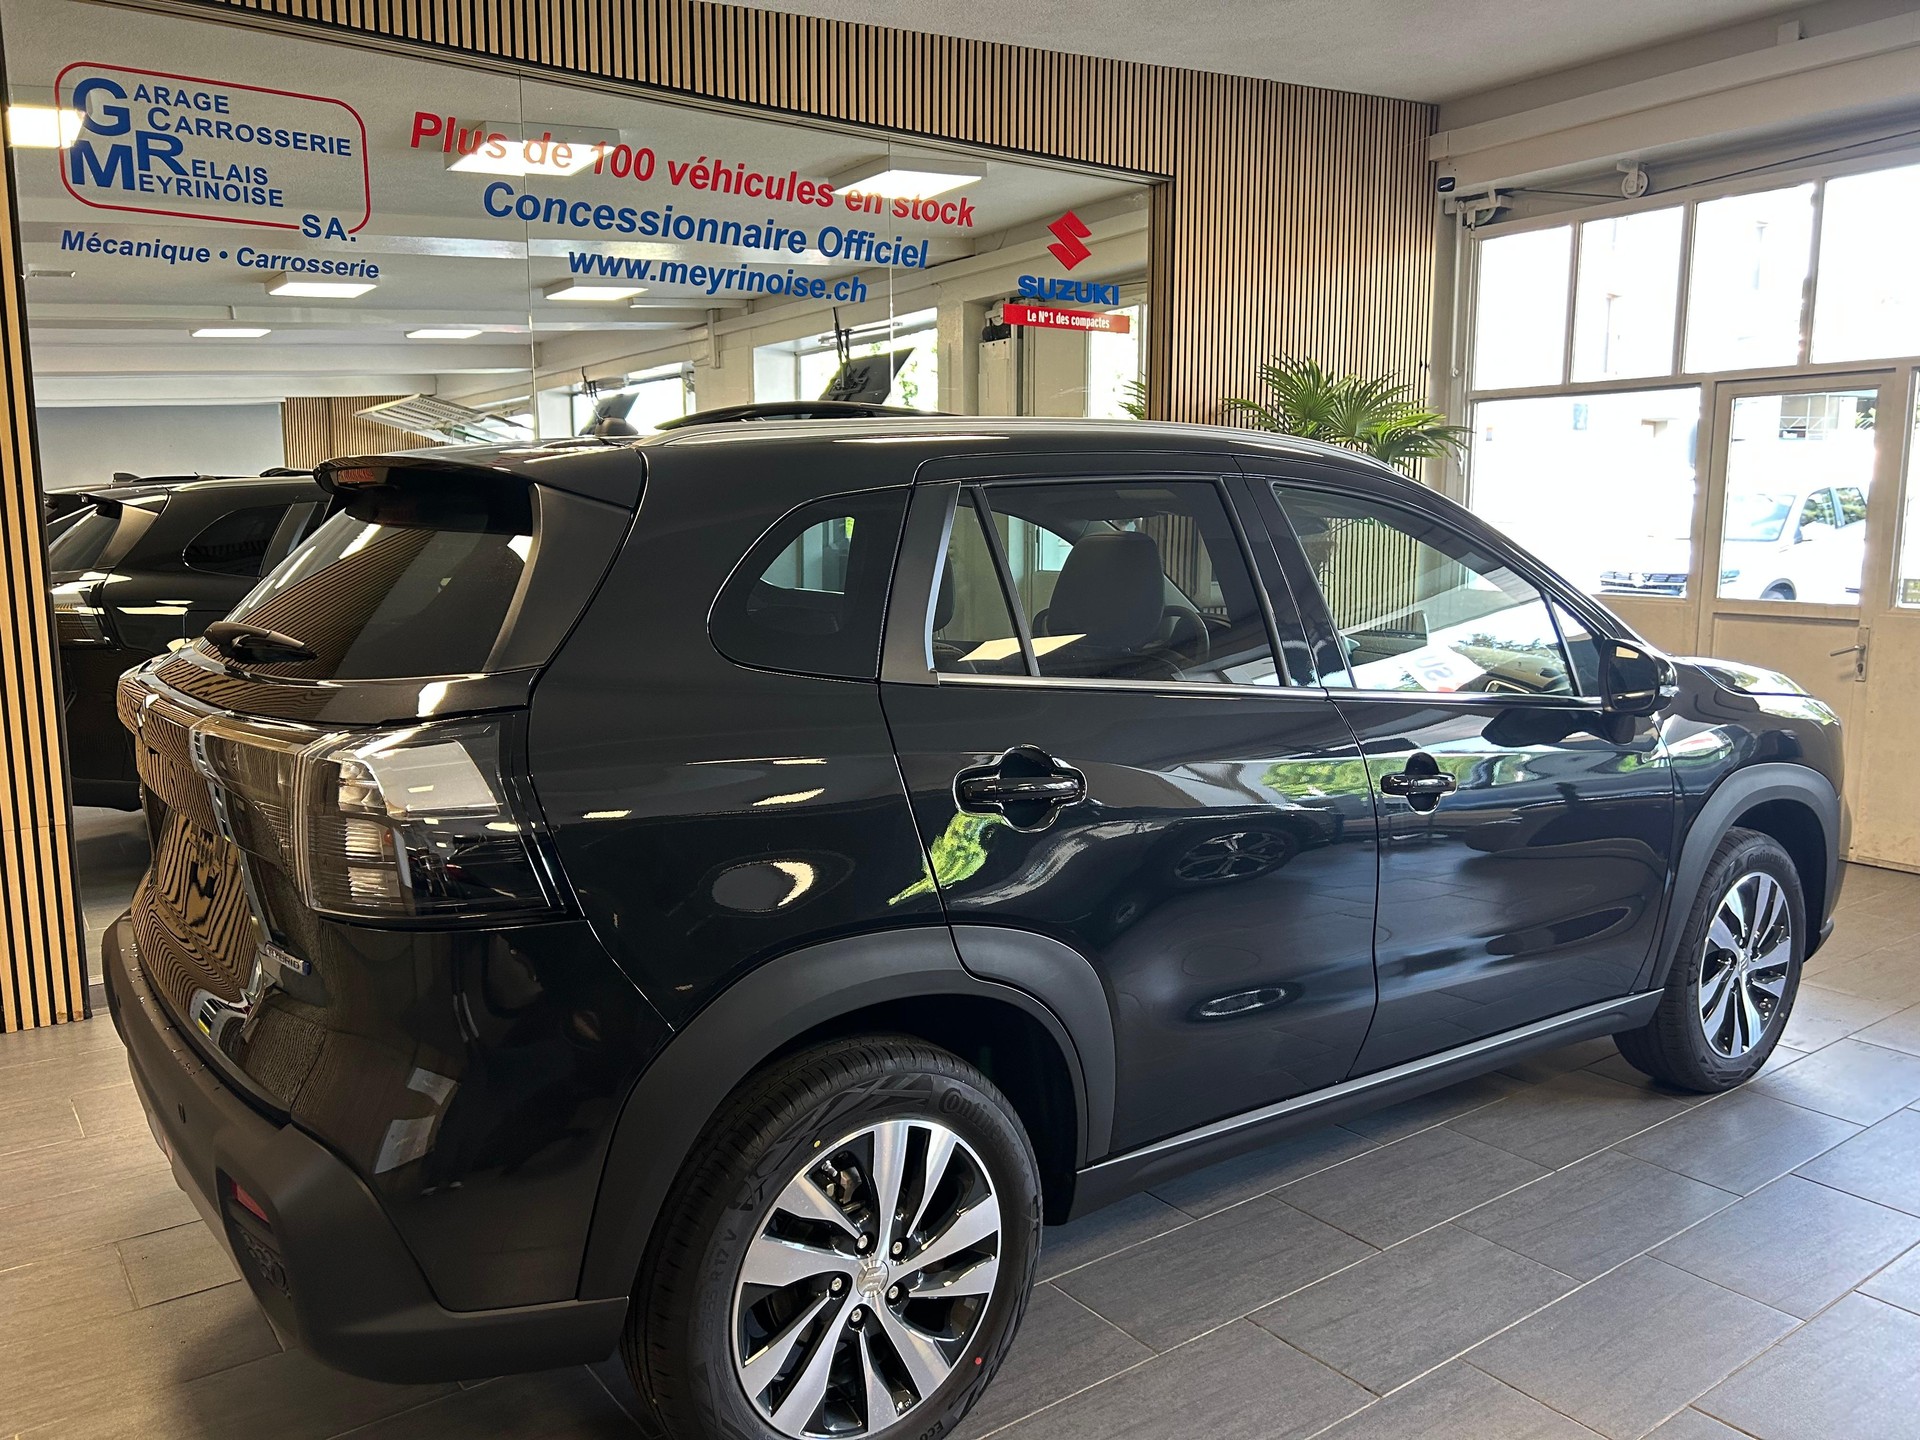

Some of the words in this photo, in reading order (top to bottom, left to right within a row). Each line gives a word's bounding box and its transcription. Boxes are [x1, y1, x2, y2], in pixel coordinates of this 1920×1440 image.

[72, 77, 230, 136] GARAGE
[147, 107, 352, 157] CARROSSERIE
[70, 140, 284, 208] MEYRINOISE
[136, 131, 269, 186] RELAIS
[410, 111, 508, 159] Plus
[524, 131, 573, 169] de
[591, 141, 657, 182] 100
[667, 155, 835, 208] véhicules
[844, 188, 883, 214] en
[891, 194, 976, 227] stock
[301, 214, 356, 242] SA.
[483, 182, 807, 254] Concessionnaire
[817, 226, 929, 269] Officiel
[61, 229, 210, 266] Mécanique
[235, 247, 380, 278] Carrosserie
[569, 251, 868, 303] www.meyrinoise.ch
[1018, 274, 1120, 306] SUZUKI
[1027, 309, 1037, 322] Le
[1056, 312, 1070, 325] des
[1070, 315, 1110, 329] compactes
